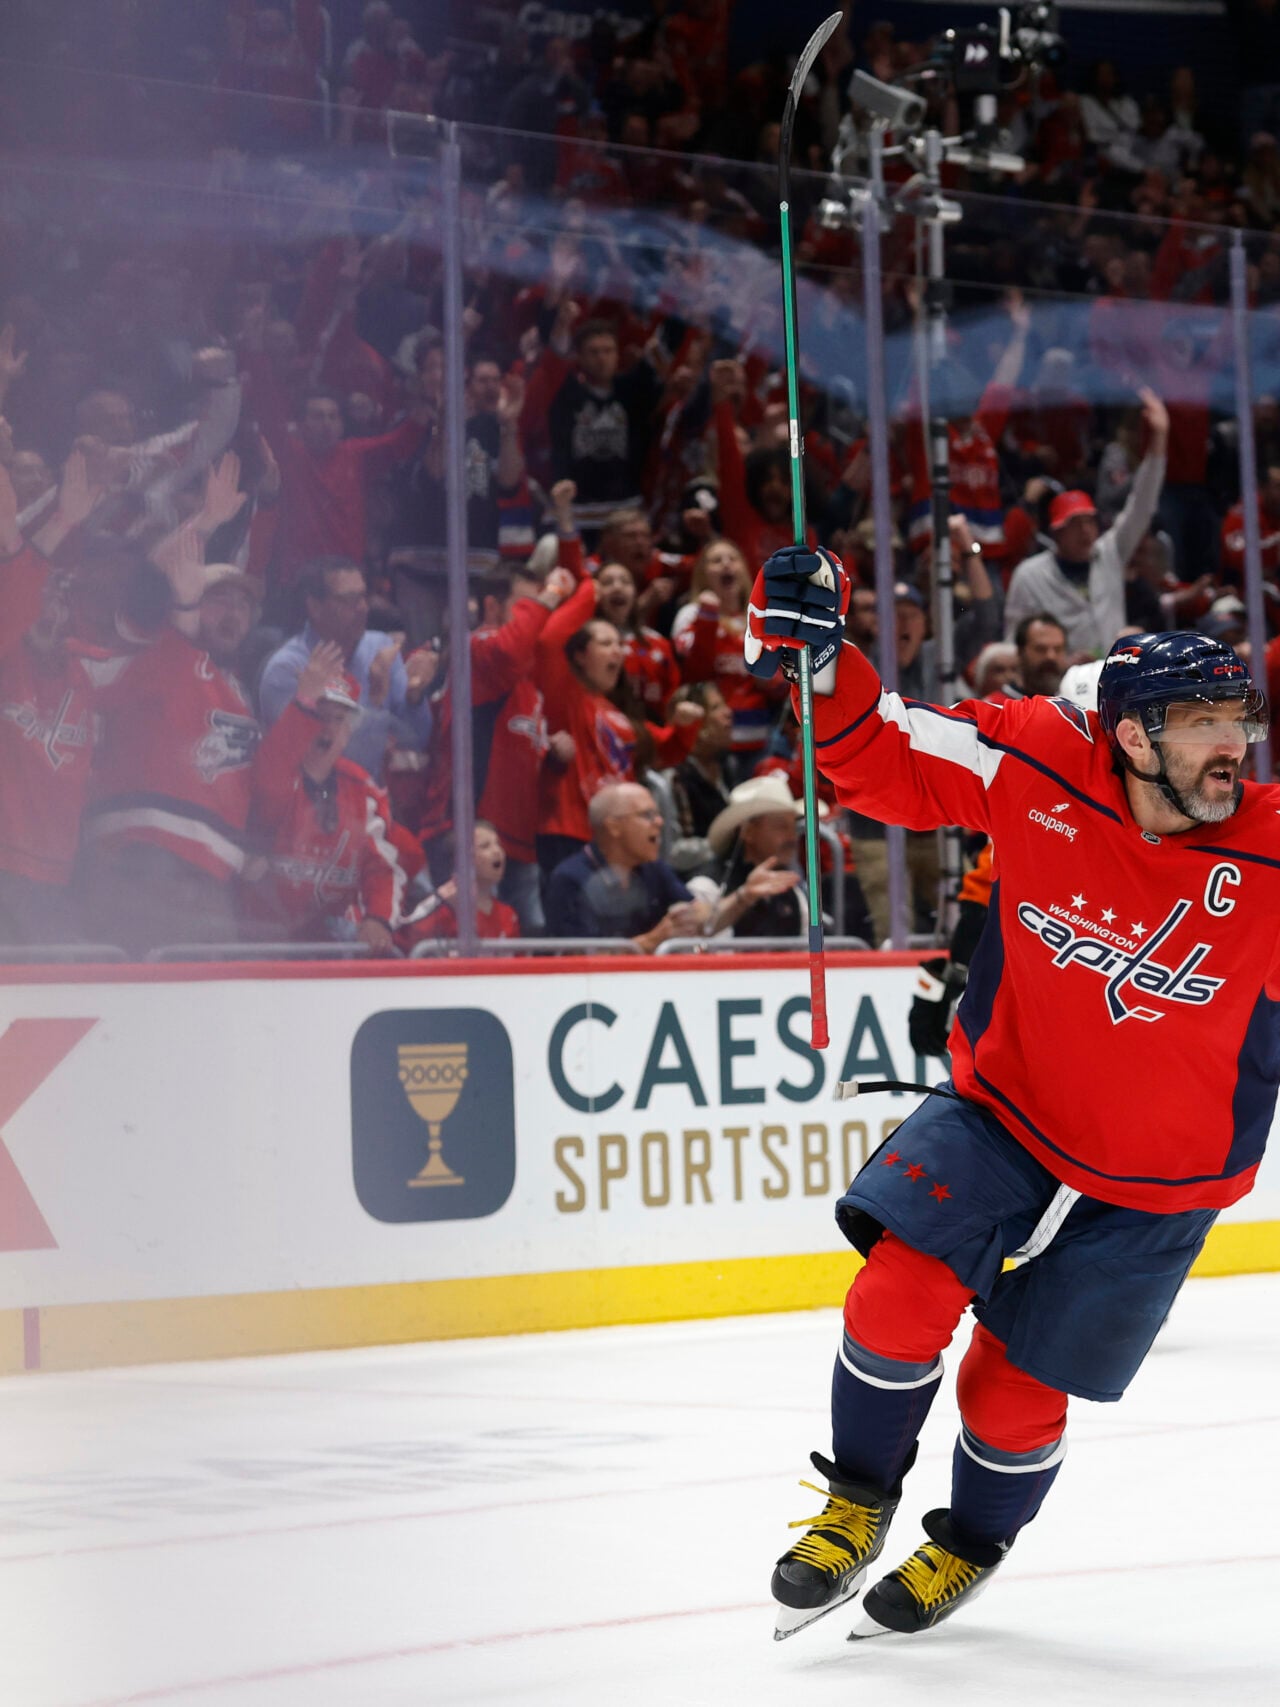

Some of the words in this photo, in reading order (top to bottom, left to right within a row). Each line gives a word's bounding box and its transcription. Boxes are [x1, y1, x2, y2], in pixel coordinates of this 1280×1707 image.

[1213, 665, 1243, 675] CCM
[1028, 808, 1078, 842] coupang
[1204, 862, 1241, 917] C
[1048, 903, 1138, 950] WASHINGTON
[1017, 898, 1226, 1025] capitals
[554, 1118, 905, 1214] SPORTSBO
